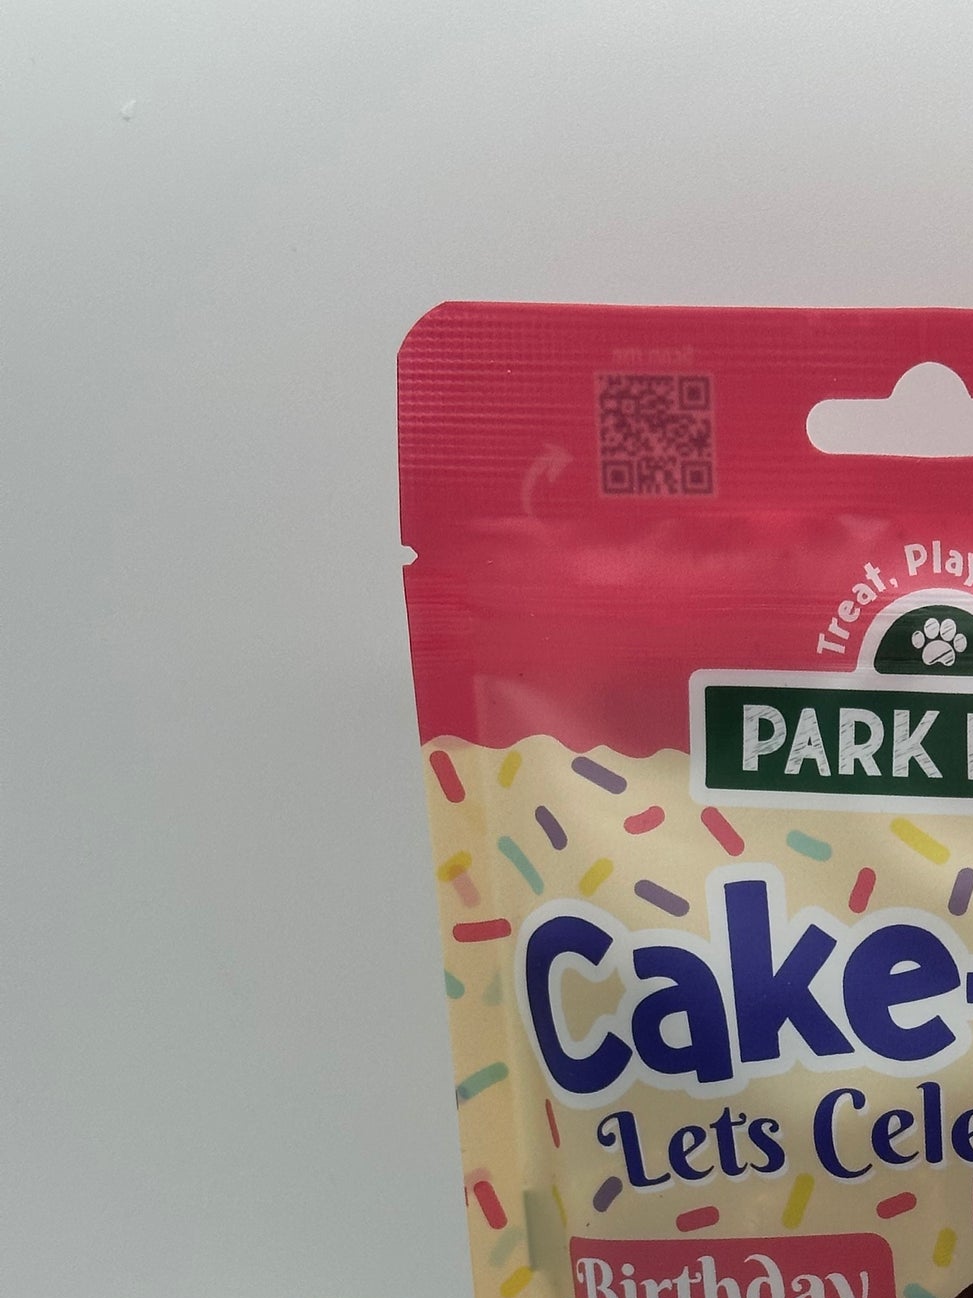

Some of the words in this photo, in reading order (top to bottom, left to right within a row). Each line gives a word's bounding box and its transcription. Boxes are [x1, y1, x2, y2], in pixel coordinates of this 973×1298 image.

[816, 561, 898, 654] Treat,
[741, 703, 944, 779] PARK
[597, 1106, 786, 1188] Lets
